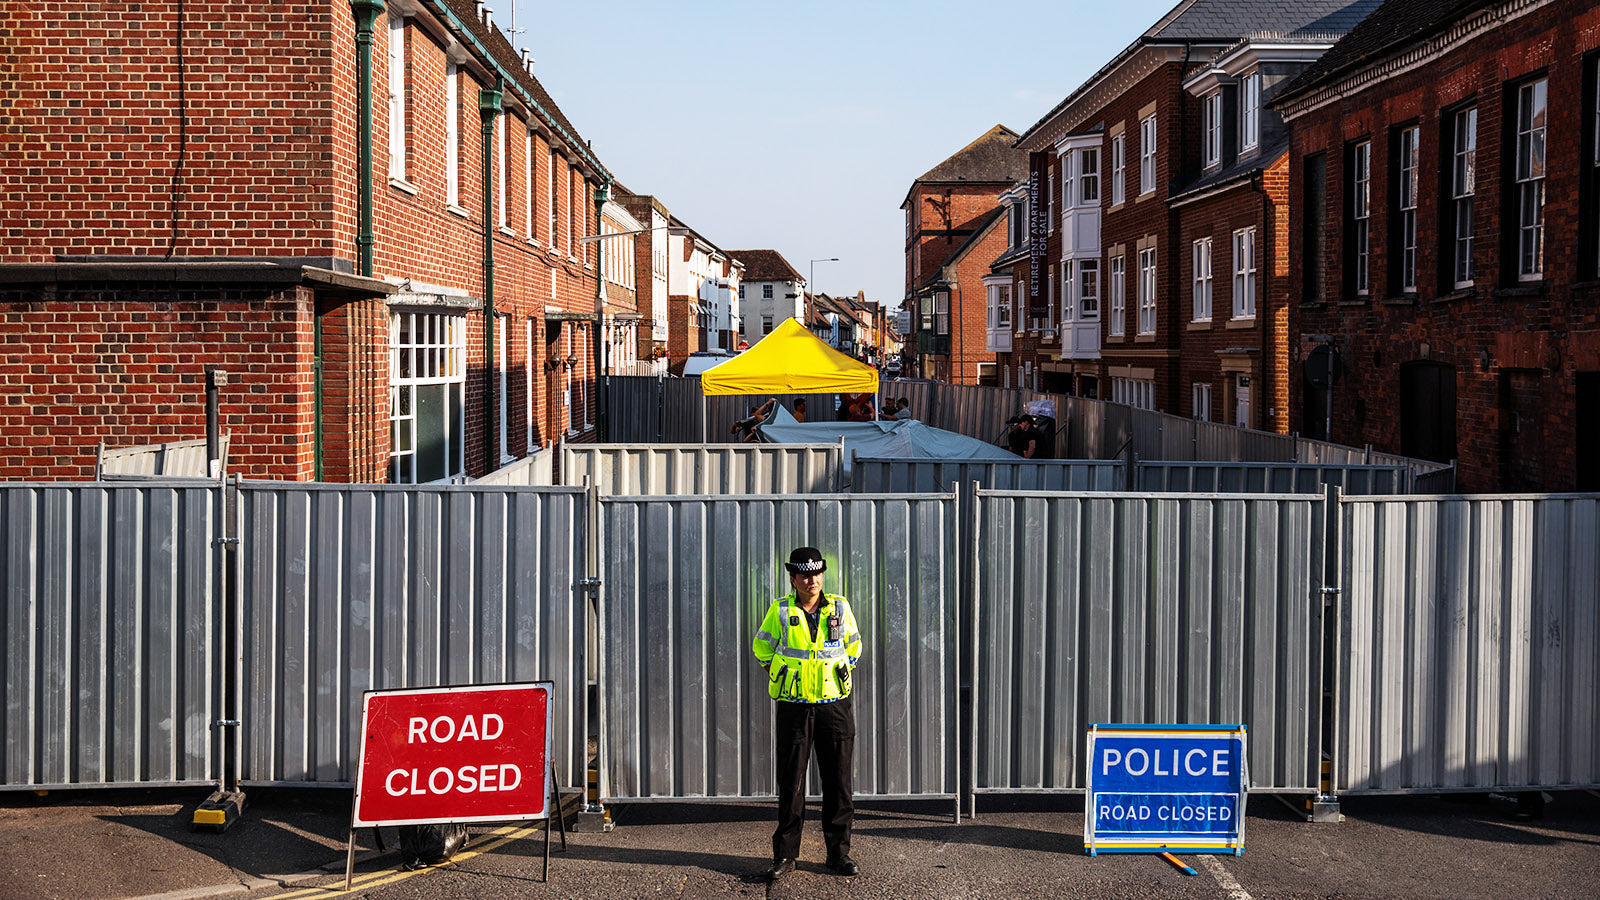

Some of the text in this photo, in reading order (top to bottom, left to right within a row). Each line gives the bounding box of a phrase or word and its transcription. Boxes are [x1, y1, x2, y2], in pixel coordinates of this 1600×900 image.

[1031, 171, 1039, 296] RETIREMENT APARTMENTS
[1039, 211, 1047, 256] FOR SALE
[408, 713, 504, 744] ROAD
[1102, 748, 1230, 776] POLICE
[385, 763, 522, 797] CLOSED
[1100, 805, 1231, 821] ROAD CLOSED
